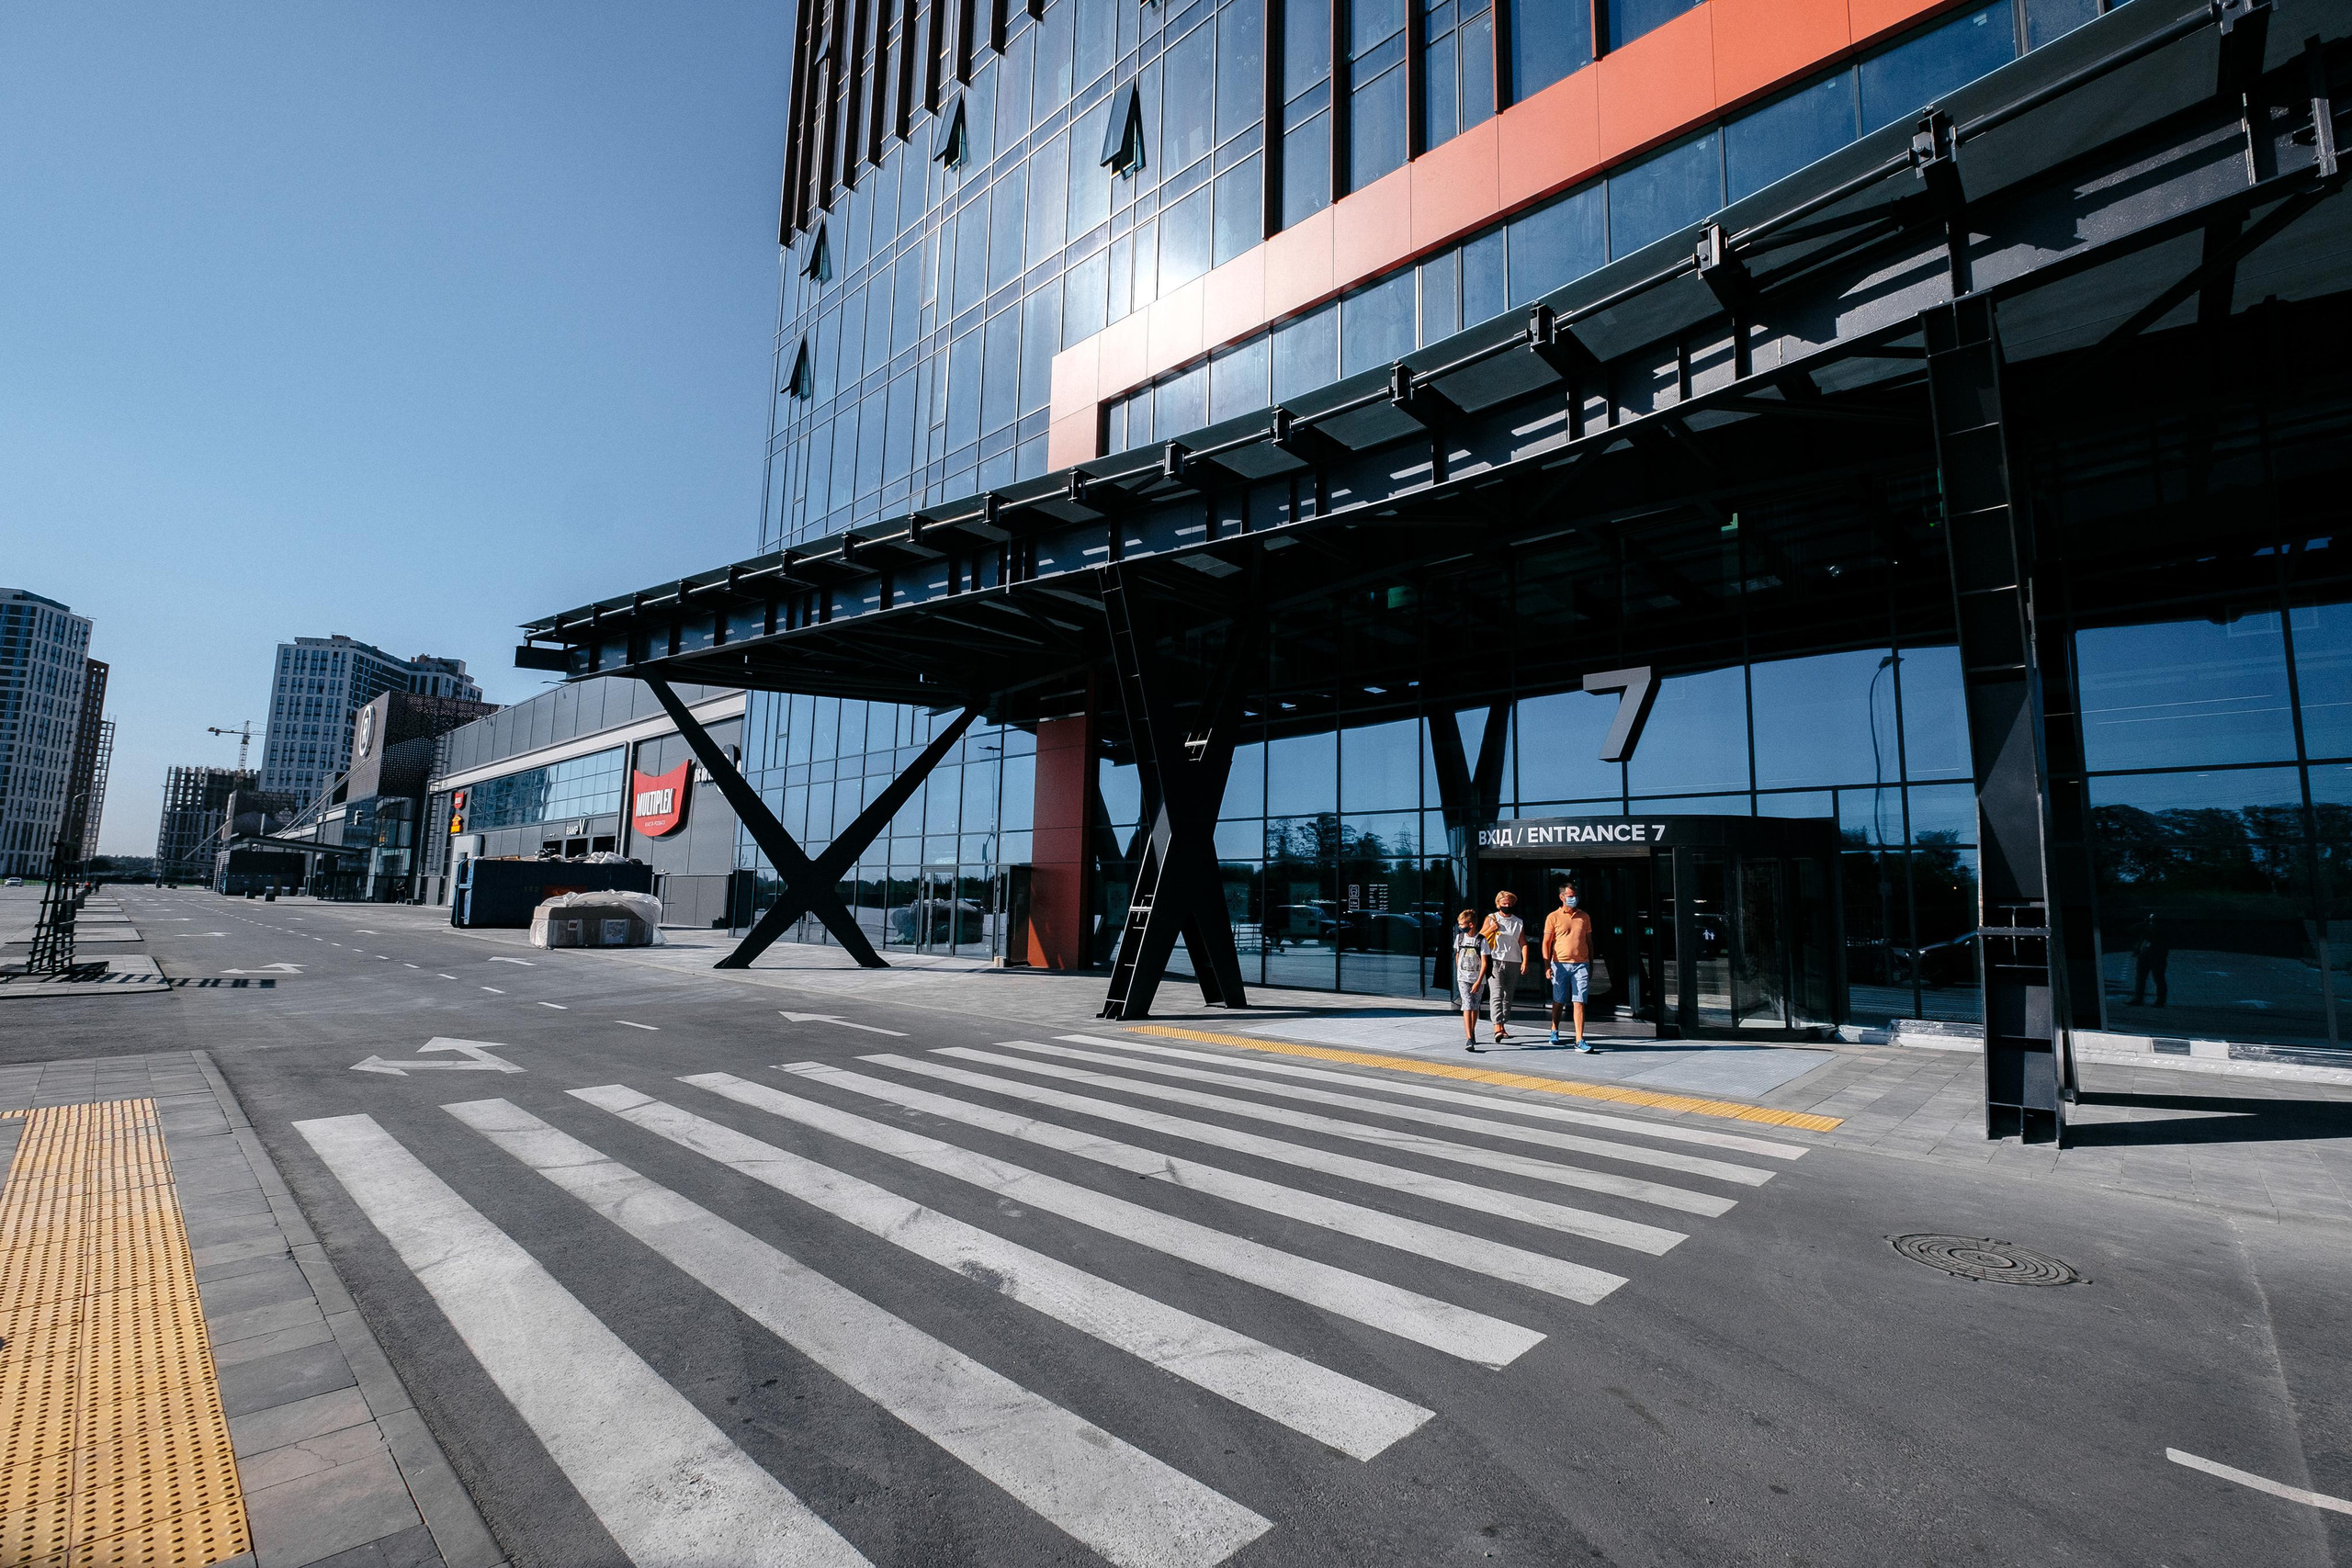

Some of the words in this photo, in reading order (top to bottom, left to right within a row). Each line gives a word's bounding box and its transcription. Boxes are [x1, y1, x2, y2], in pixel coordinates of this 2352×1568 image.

[1583, 666, 1660, 762] 7
[635, 788, 674, 818] MULTIPLEX
[1478, 829, 1513, 846] ВХІД
[1527, 824, 1645, 843] ENTRANCE
[1651, 824, 1666, 841] 7
